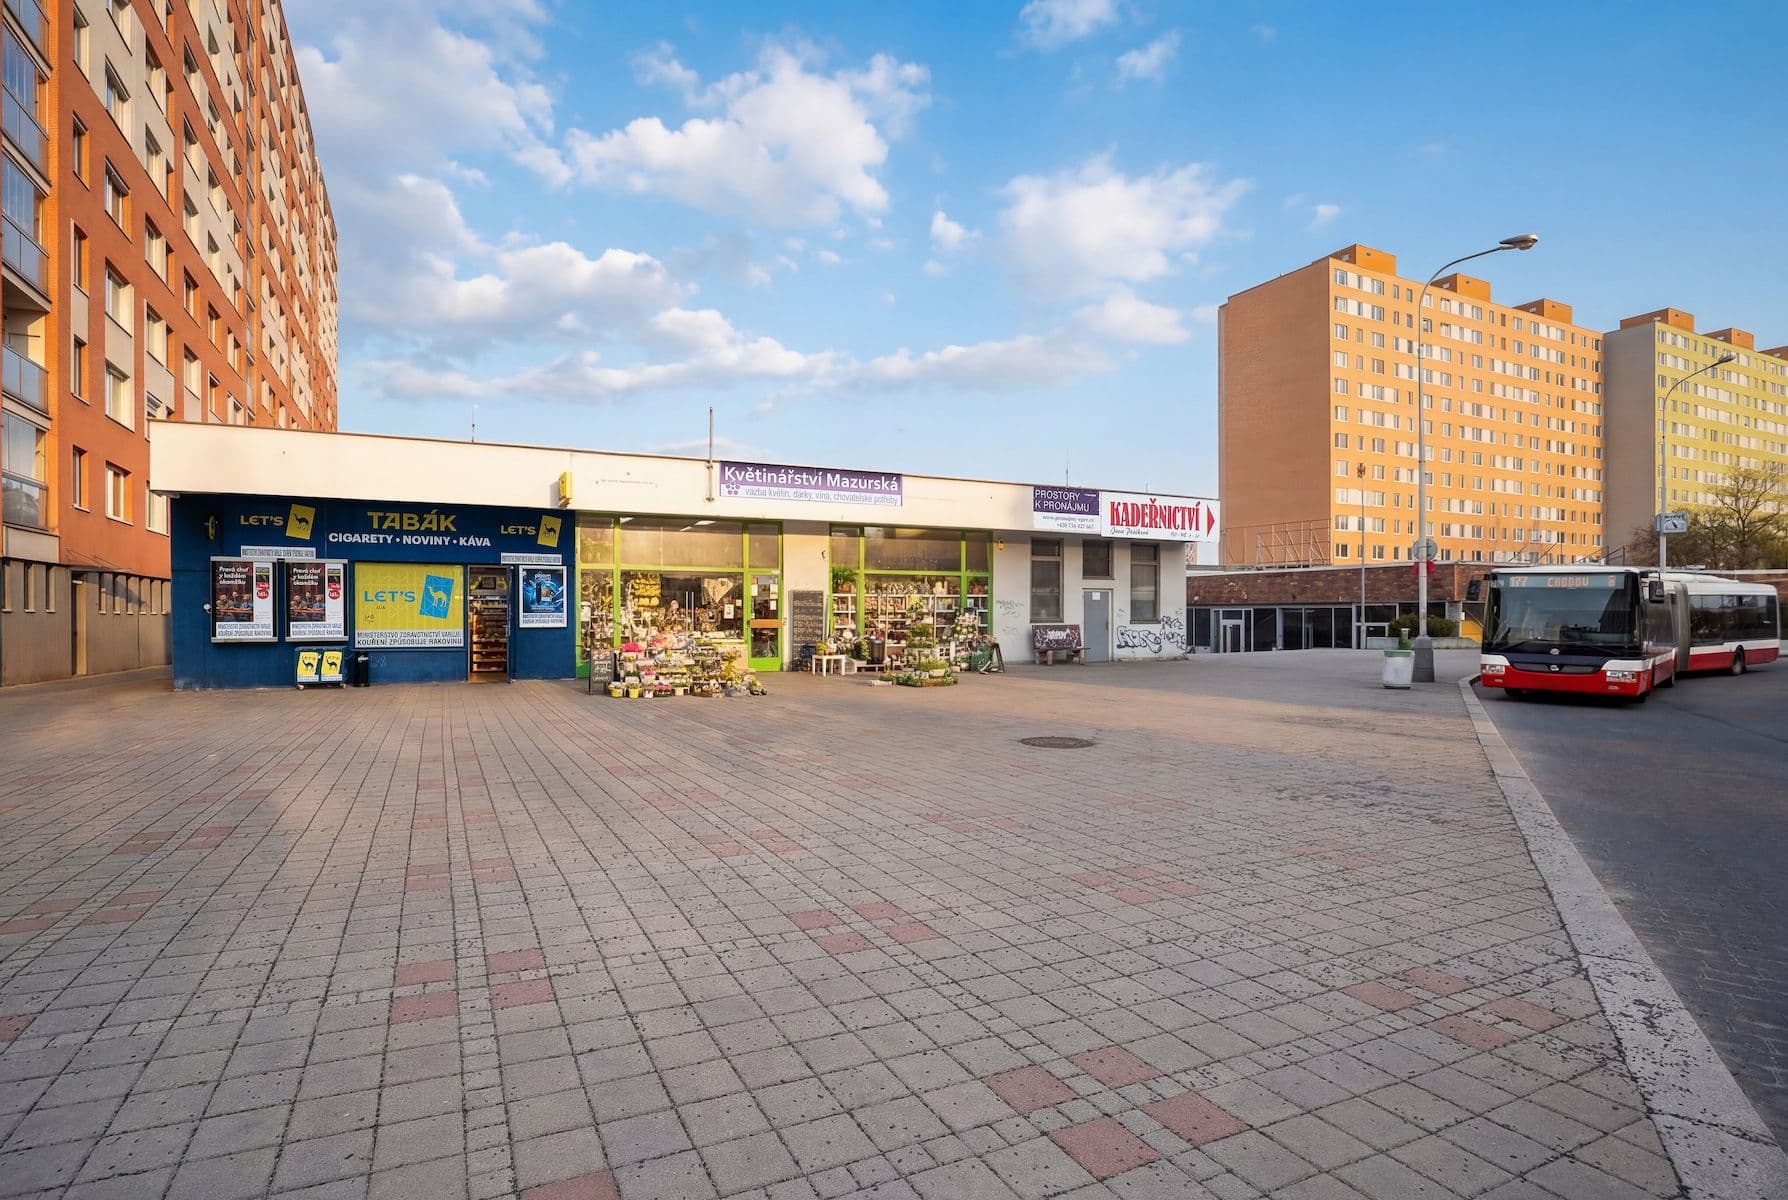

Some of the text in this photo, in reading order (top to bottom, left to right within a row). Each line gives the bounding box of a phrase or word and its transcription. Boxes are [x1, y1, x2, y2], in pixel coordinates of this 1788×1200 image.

[725, 466, 898, 492] Květinářství Mazurská
[745, 487, 766, 496] vazba
[793, 490, 813, 500] dárky,
[874, 494, 898, 504] potřeby
[1035, 490, 1080, 500] PROSTORY
[1035, 500, 1090, 512] K PRONÁJMU
[240, 515, 284, 527] LET'S
[367, 510, 457, 532] TABÁK
[1110, 498, 1200, 531] KADEŘNICTVÍ
[500, 524, 536, 536] LET'S
[328, 532, 492, 548] CIGARETY NOVINY KÁVA
[364, 590, 416, 603] LET'S
